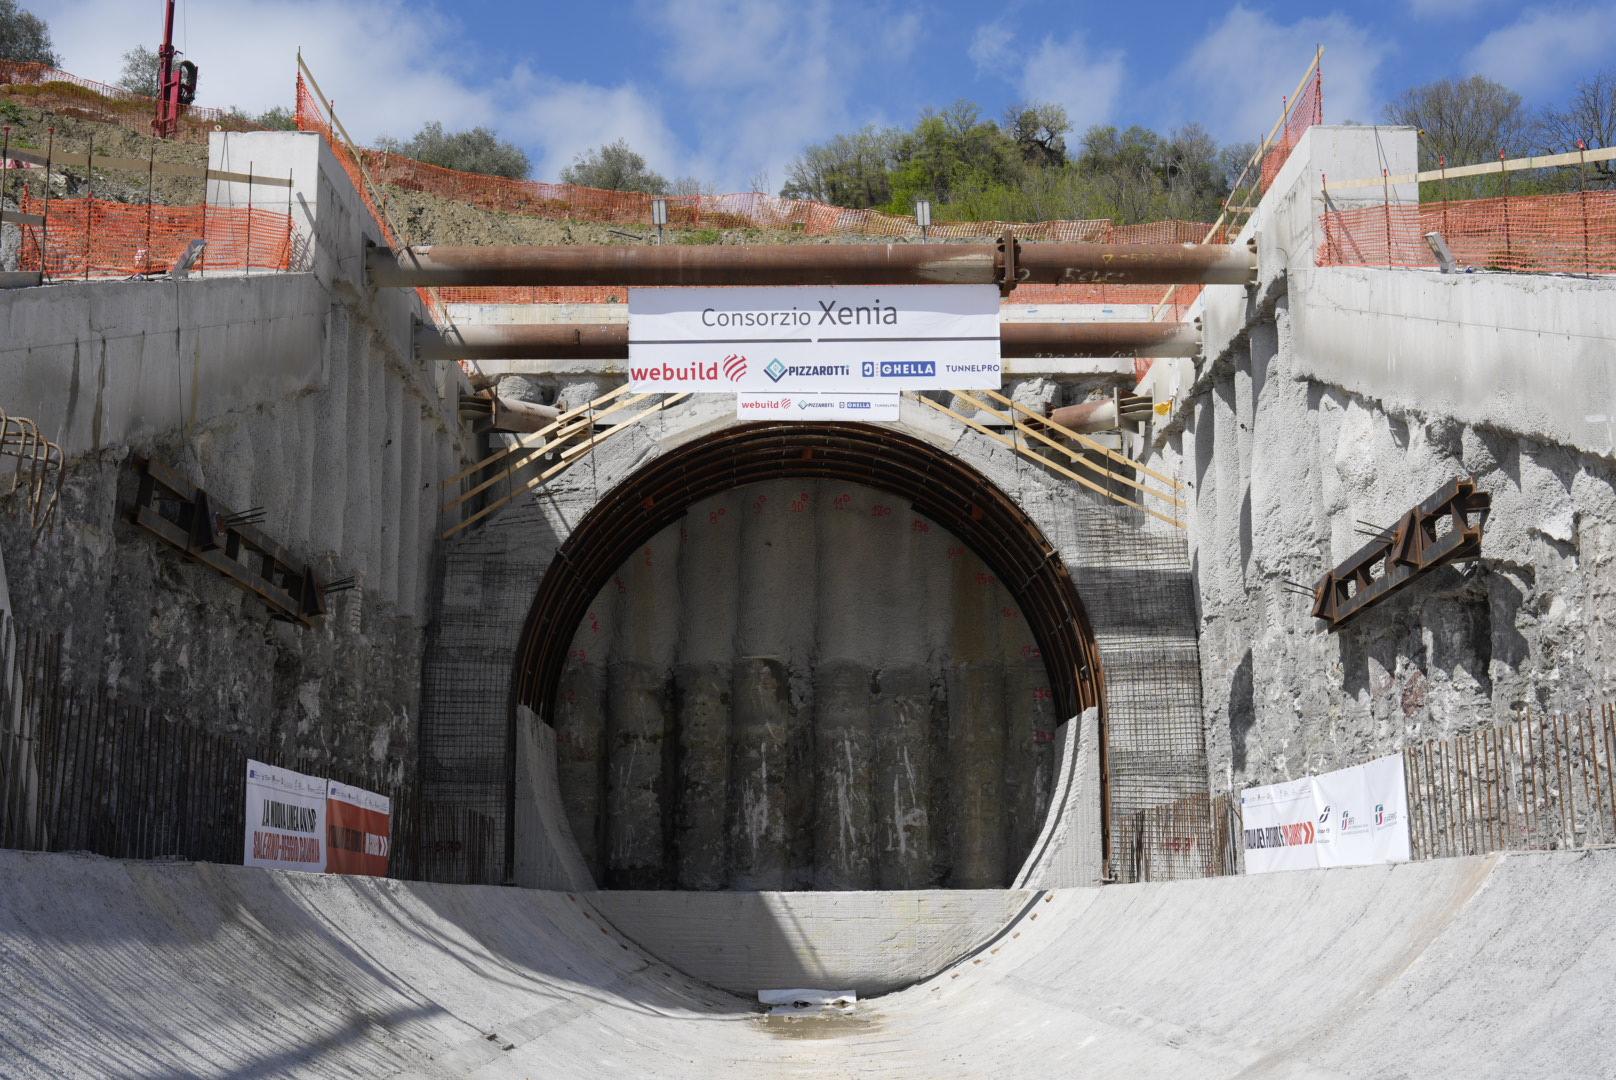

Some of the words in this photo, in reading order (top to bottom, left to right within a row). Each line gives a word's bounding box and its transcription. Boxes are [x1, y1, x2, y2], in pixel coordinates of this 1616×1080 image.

[701, 307, 812, 327] Consorzio
[818, 299, 898, 326] Xenia
[630, 362, 718, 381] webuild
[881, 363, 934, 376] GHELLA
[946, 364, 1000, 374] TUNNELPRO
[741, 401, 779, 409] webuild
